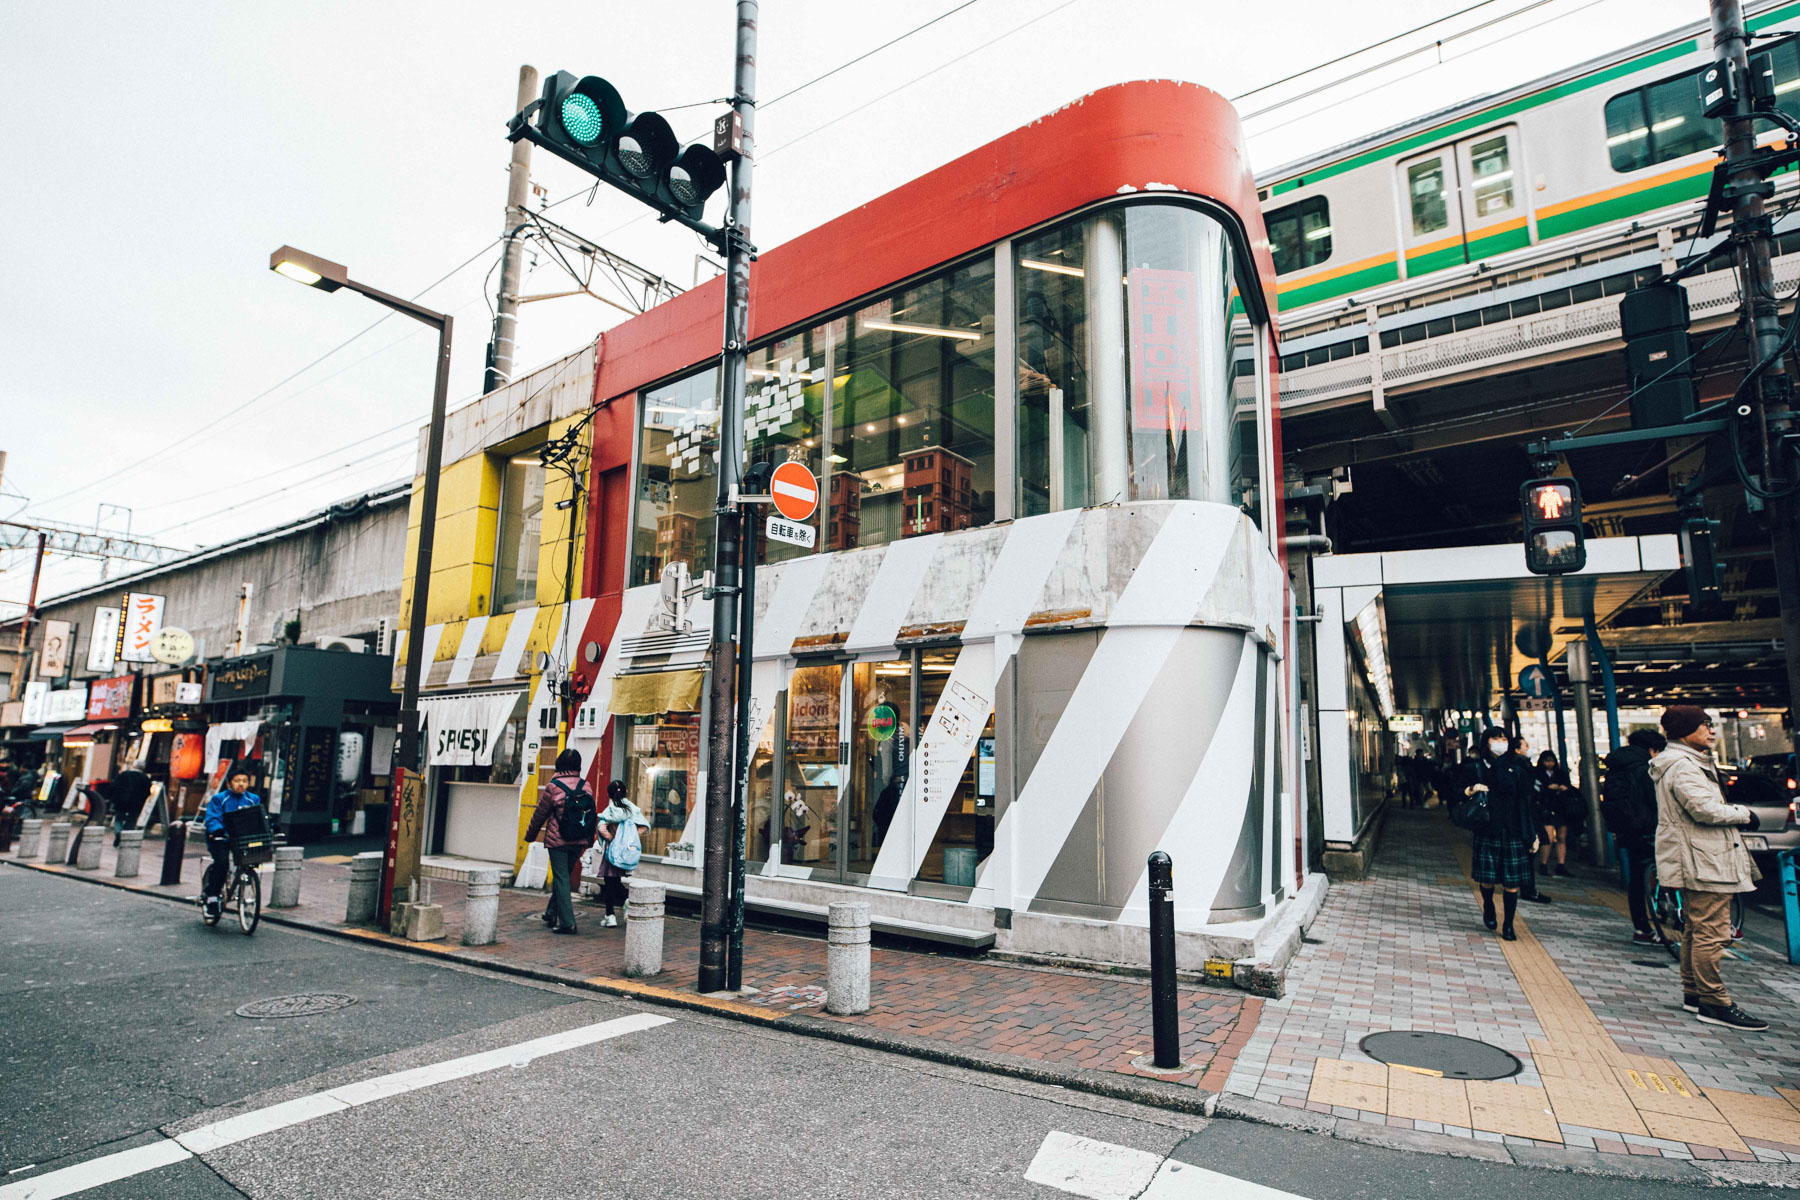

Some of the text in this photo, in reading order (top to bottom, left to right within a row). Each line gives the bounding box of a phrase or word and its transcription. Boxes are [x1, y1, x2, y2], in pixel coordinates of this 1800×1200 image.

[771, 523, 811, 543] 自転車を除く
[872, 717, 893, 728] OPEN
